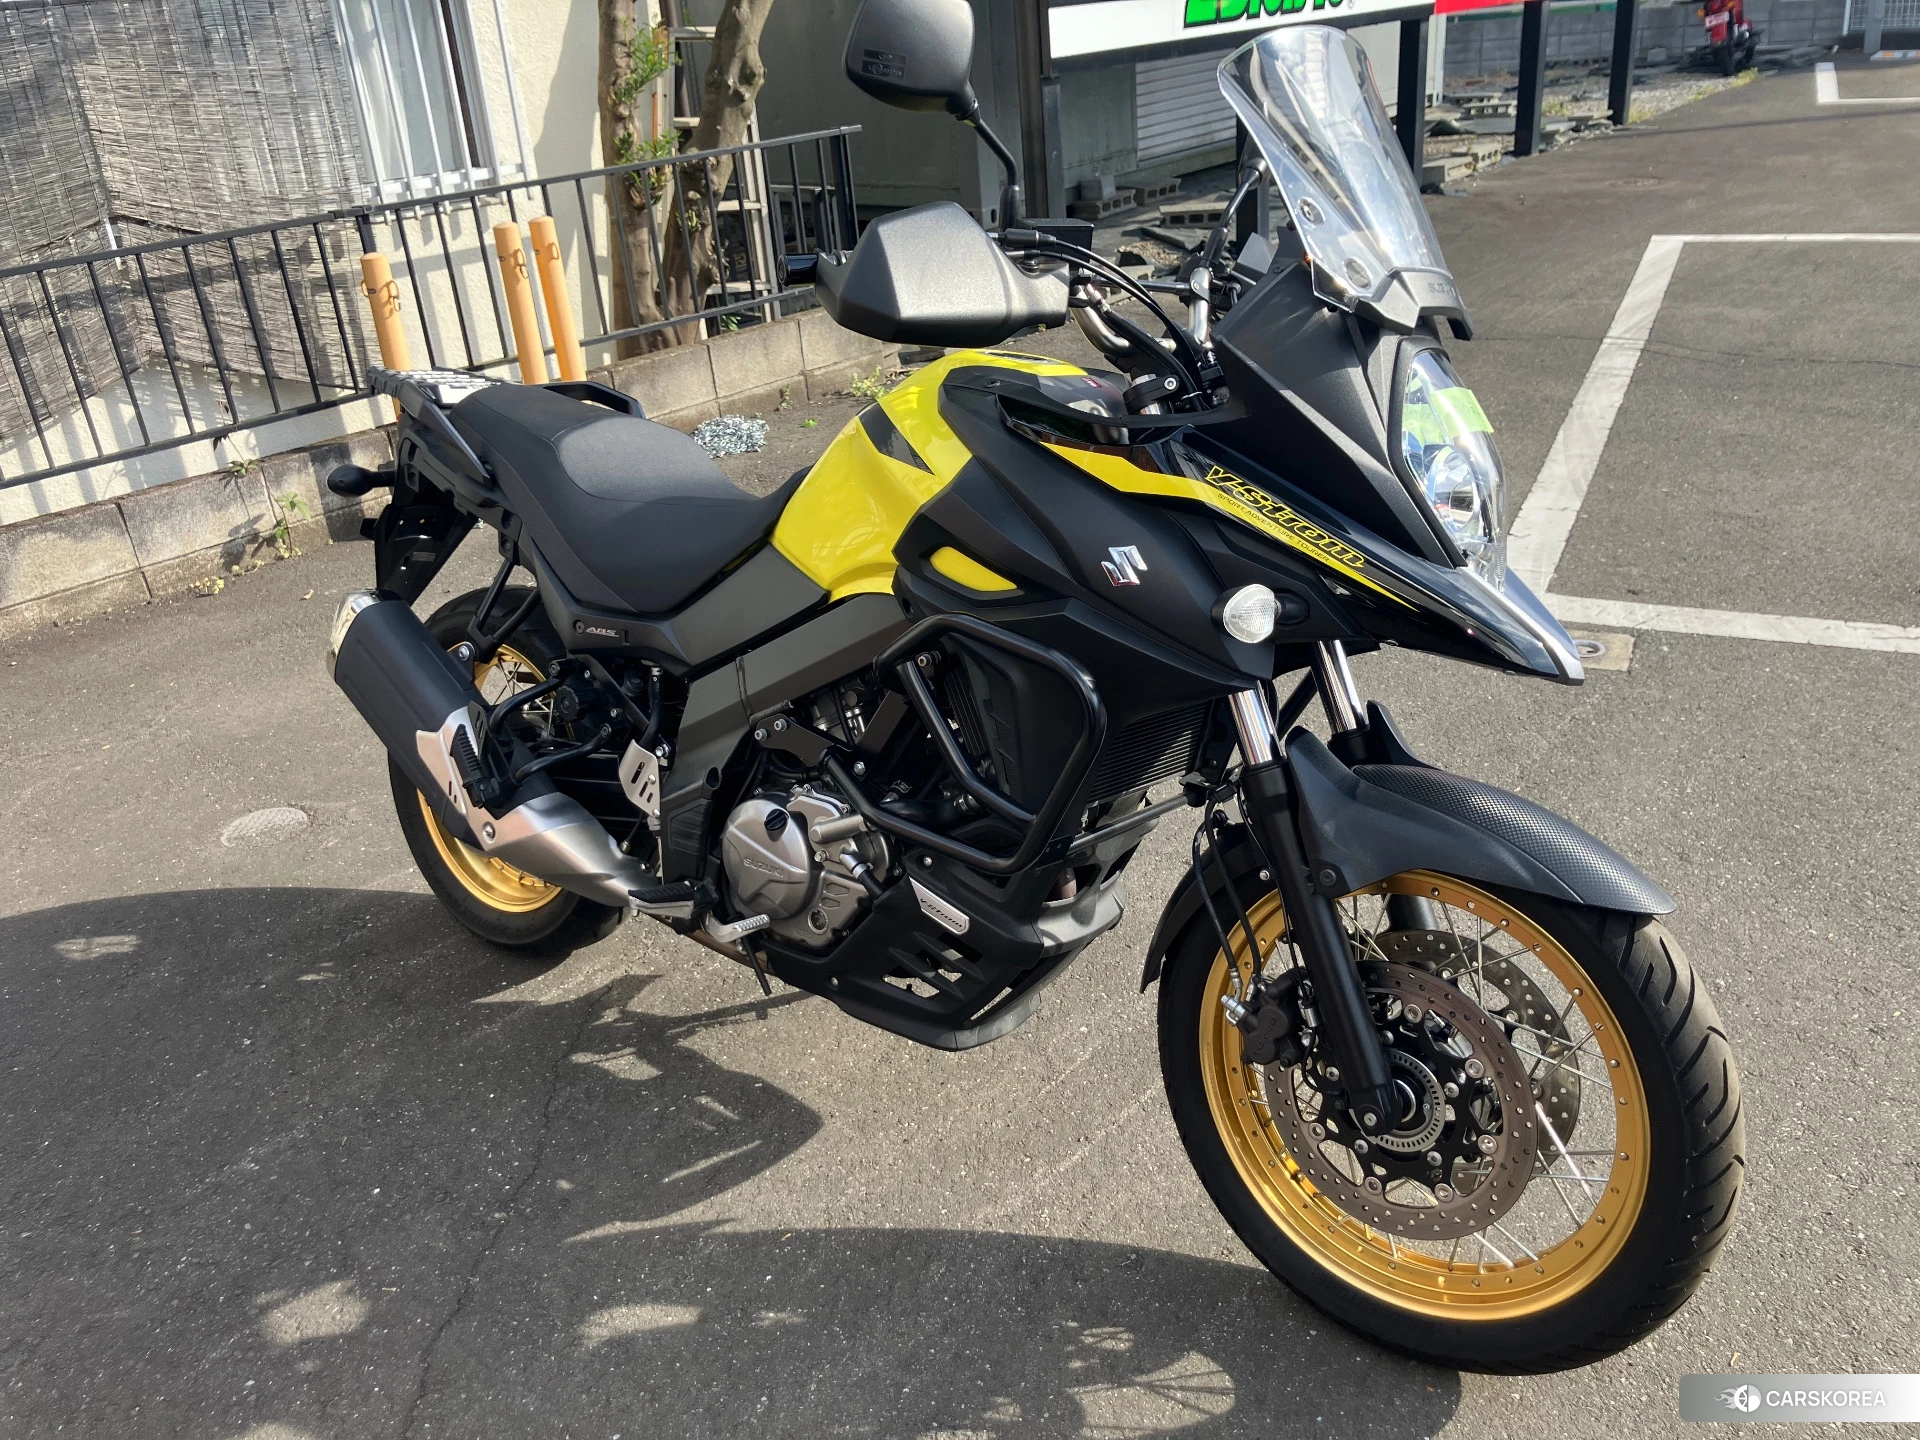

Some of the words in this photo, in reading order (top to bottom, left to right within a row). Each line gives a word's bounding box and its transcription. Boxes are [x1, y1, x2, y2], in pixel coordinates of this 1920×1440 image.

[1205, 465, 1364, 567] V-Strom
[1217, 493, 1245, 509] SPORT
[1246, 509, 1294, 541] ADVENTURE
[1296, 539, 1330, 562] TOURER
